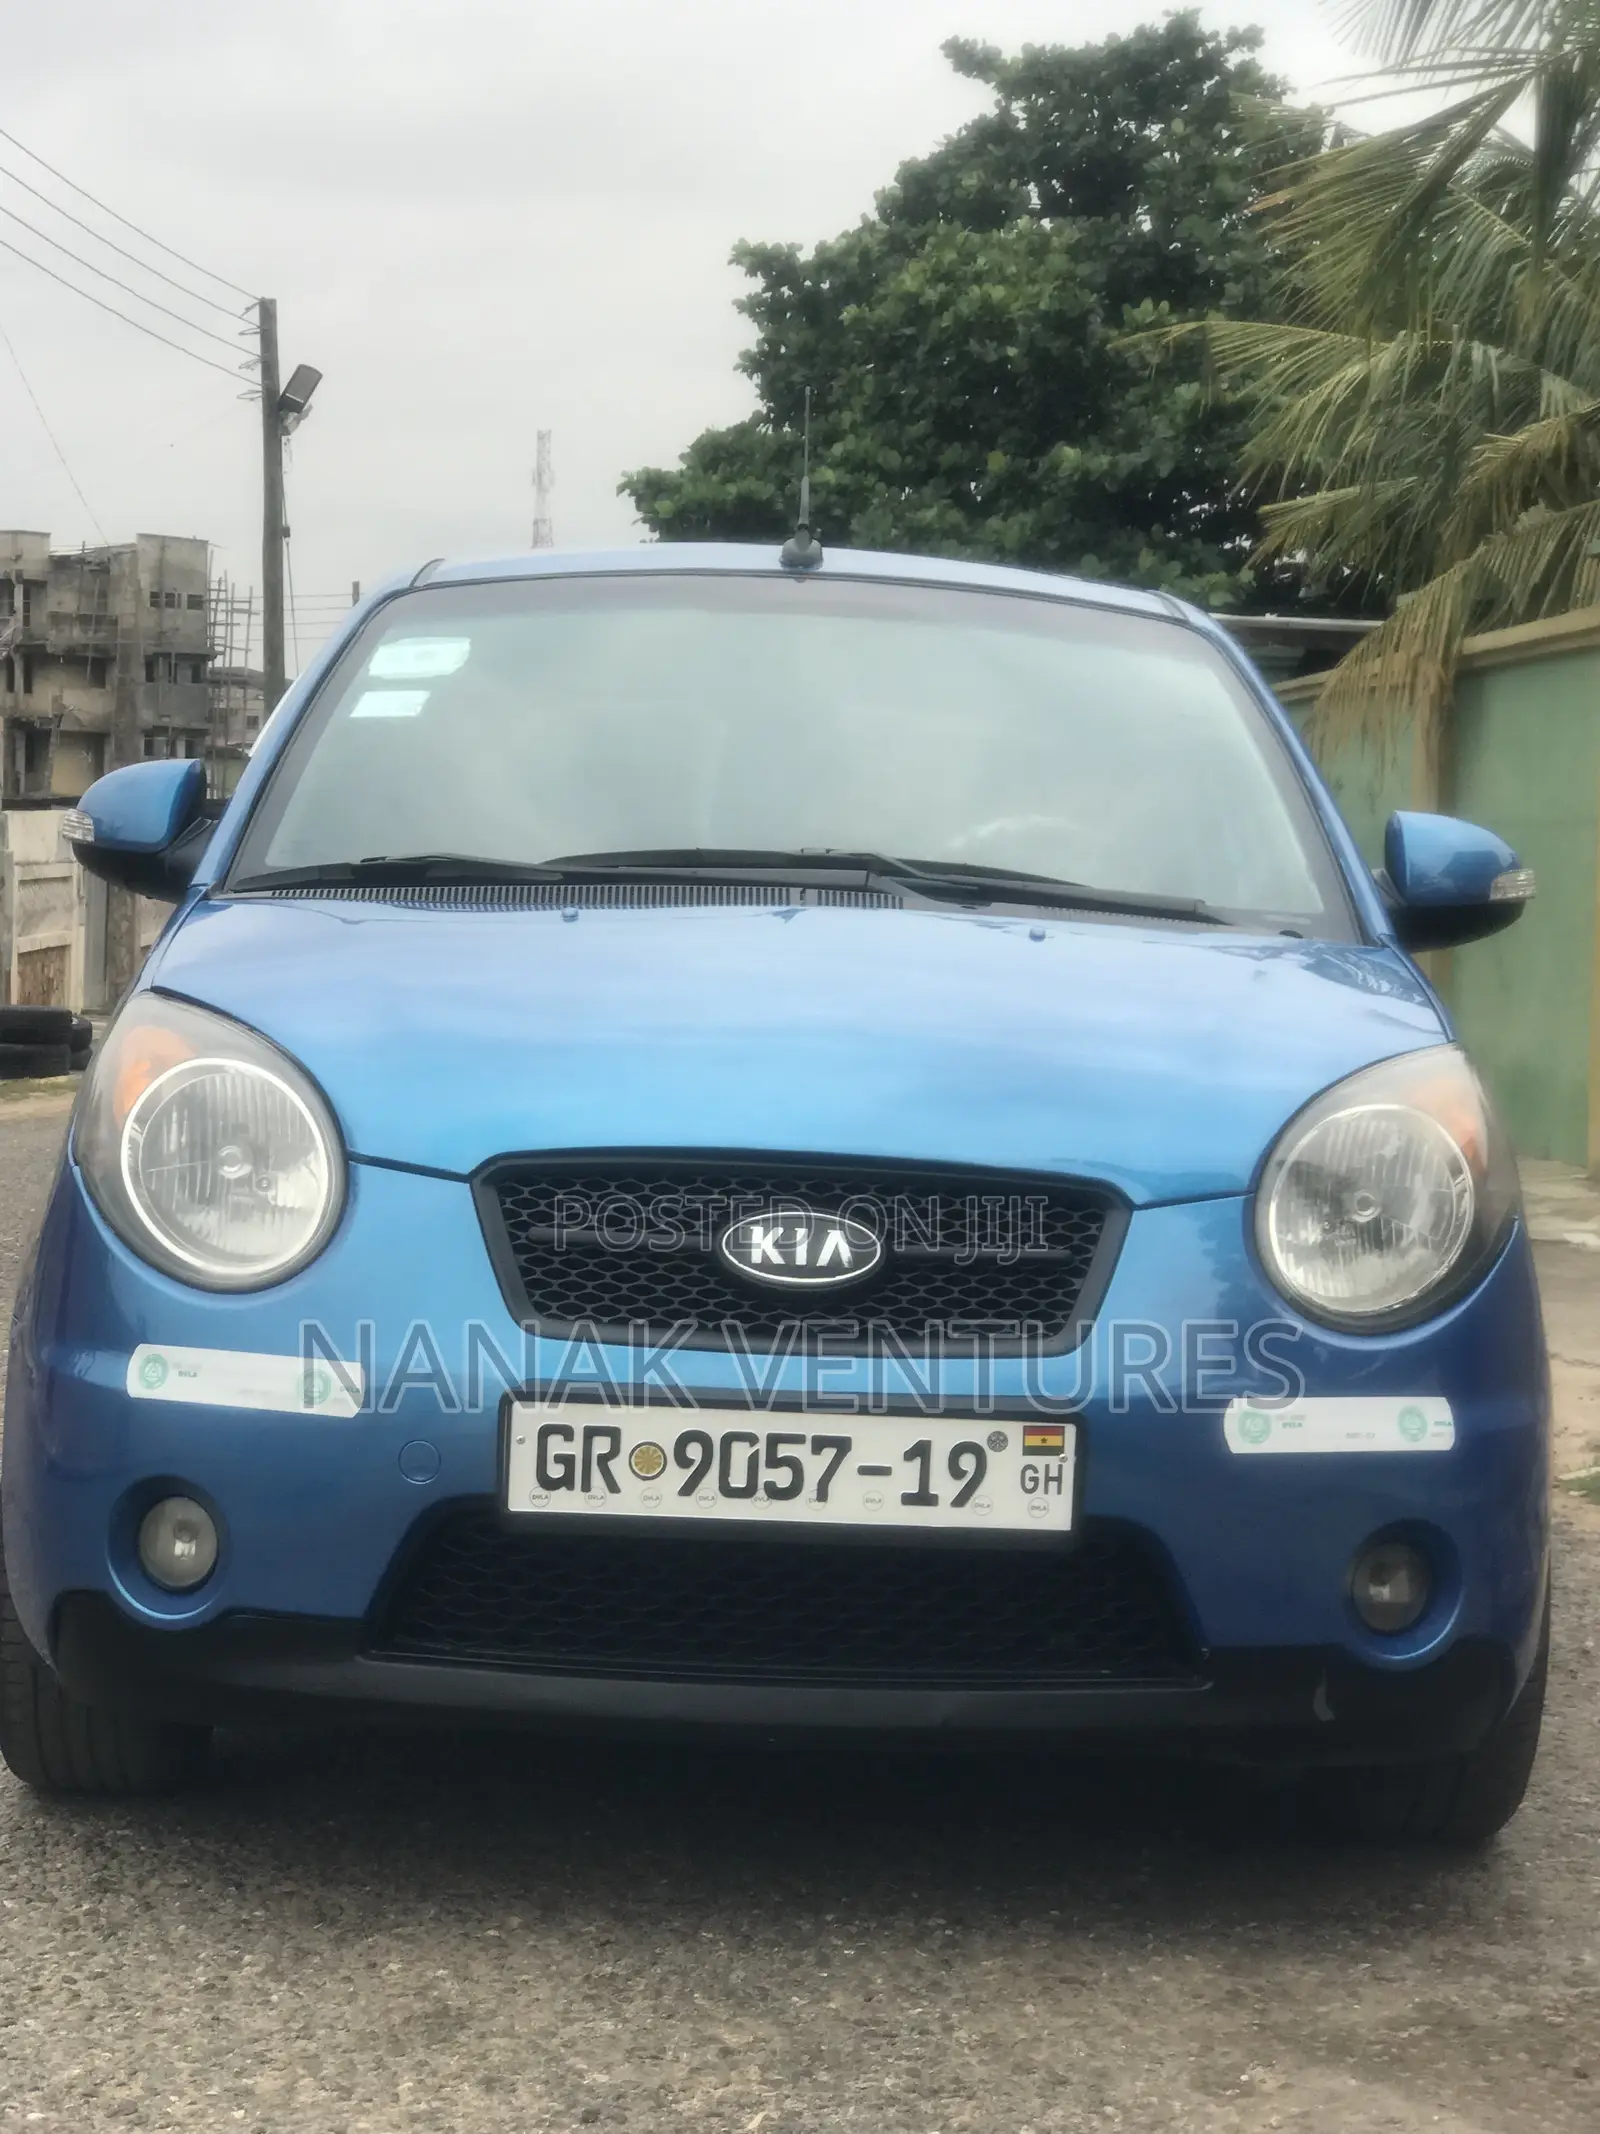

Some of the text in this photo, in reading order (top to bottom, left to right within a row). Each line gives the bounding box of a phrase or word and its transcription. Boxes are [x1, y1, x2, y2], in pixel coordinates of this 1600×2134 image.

[749, 1226, 854, 1268] KIA
[536, 1423, 988, 1508] GR 9057-19
[1020, 1463, 1063, 1495] GH
